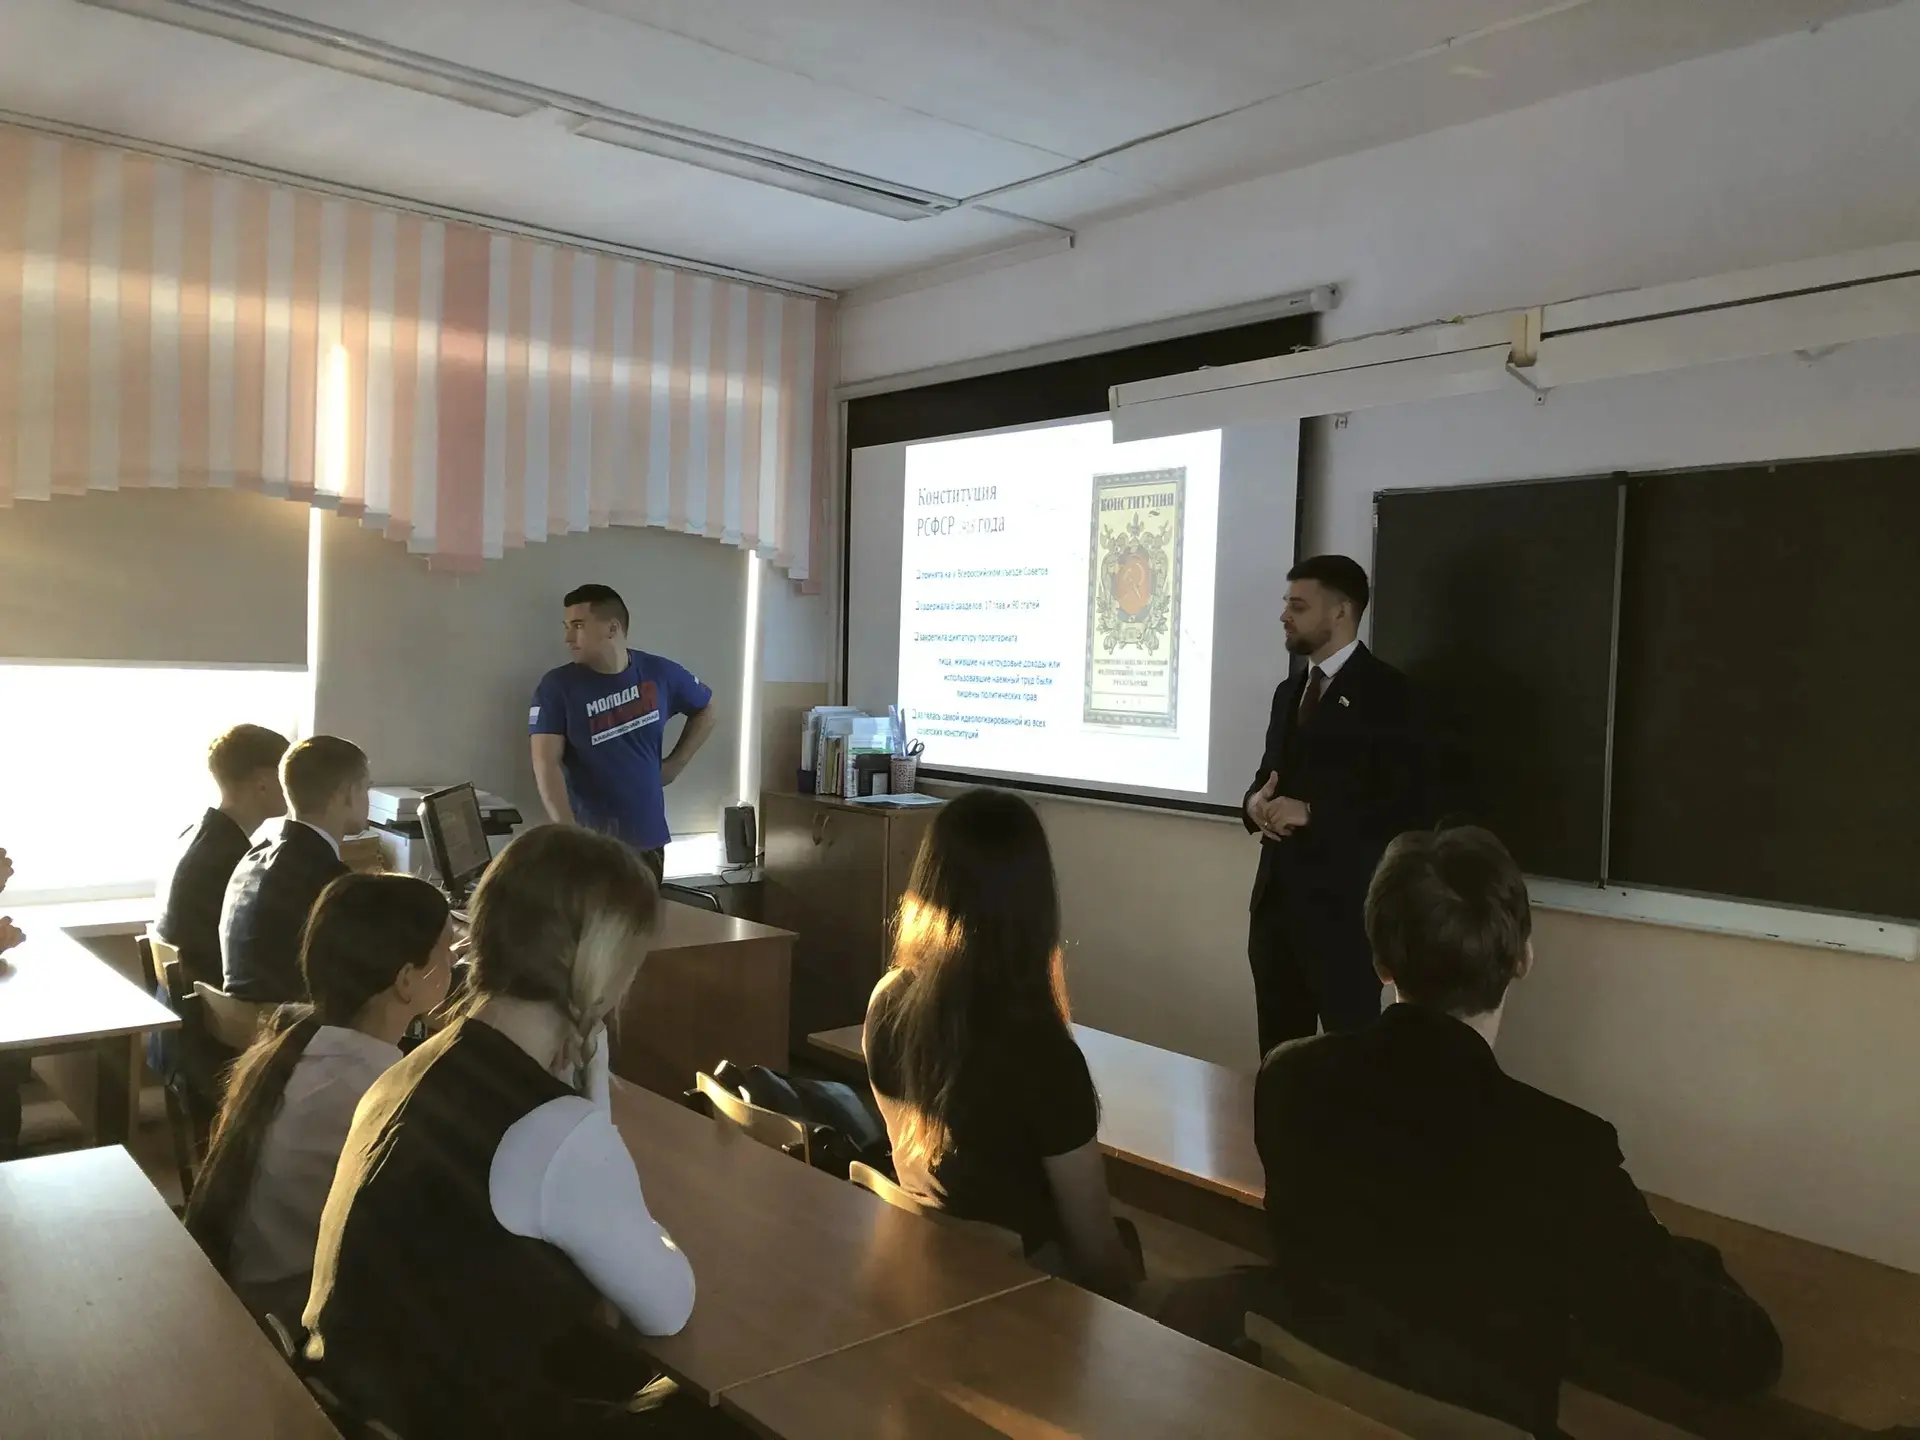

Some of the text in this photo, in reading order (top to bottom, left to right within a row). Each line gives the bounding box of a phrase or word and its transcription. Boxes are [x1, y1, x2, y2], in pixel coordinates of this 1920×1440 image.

[918, 485, 997, 507] Конституция
[1100, 492, 1174, 512] КОНСТИТУЦИЯ
[917, 515, 955, 536] РСФСР
[978, 516, 1004, 533] года
[1023, 660, 1047, 669] доходы
[1021, 677, 1035, 687] труд
[1036, 675, 1053, 686] были
